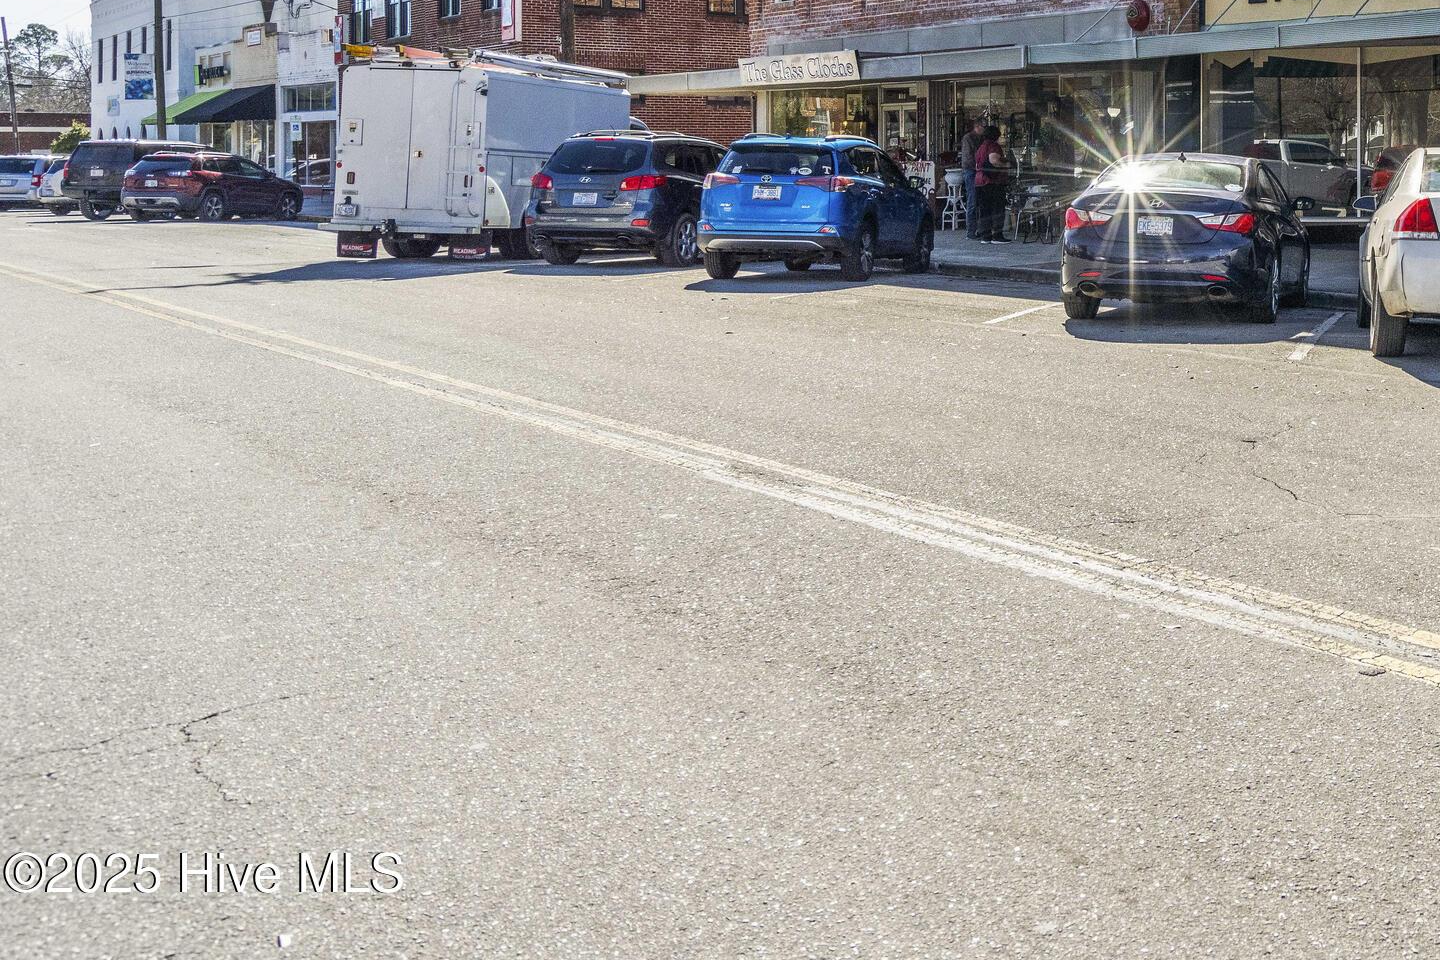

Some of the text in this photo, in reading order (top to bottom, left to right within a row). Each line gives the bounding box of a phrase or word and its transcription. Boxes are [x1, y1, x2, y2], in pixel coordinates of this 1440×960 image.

[742, 55, 854, 83] The Glass Cloche
